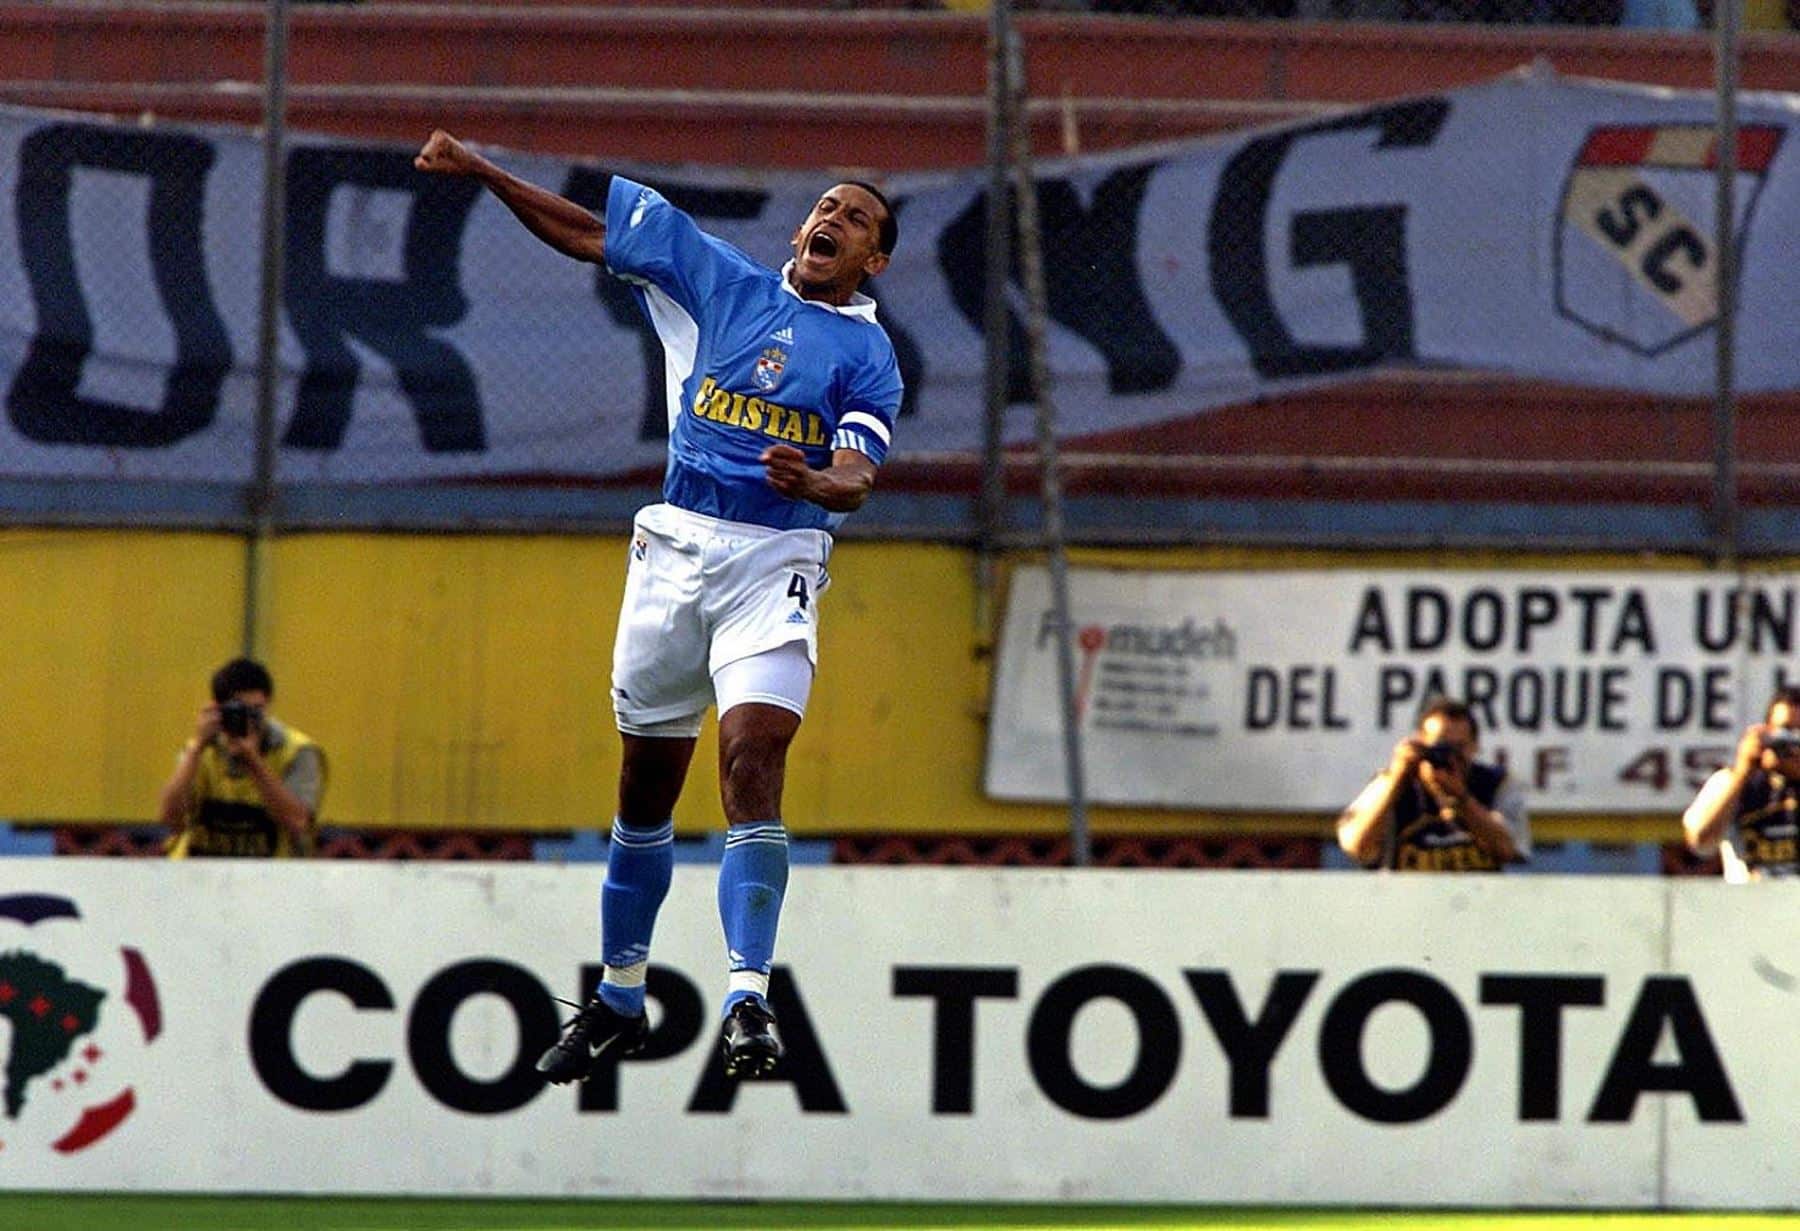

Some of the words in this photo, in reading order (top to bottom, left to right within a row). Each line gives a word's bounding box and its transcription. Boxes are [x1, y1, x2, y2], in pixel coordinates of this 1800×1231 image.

[1596, 184, 1707, 295] SC
[692, 376, 826, 447] CRISTAL
[787, 572, 810, 610] 4
[1349, 585, 1656, 654] ADOPTA
[1695, 586, 1794, 654] UN
[1244, 666, 1350, 732] DEL
[1655, 667, 1734, 732] DE
[249, 955, 850, 1115] COPA
[892, 962, 1746, 1126] TOYOTA
